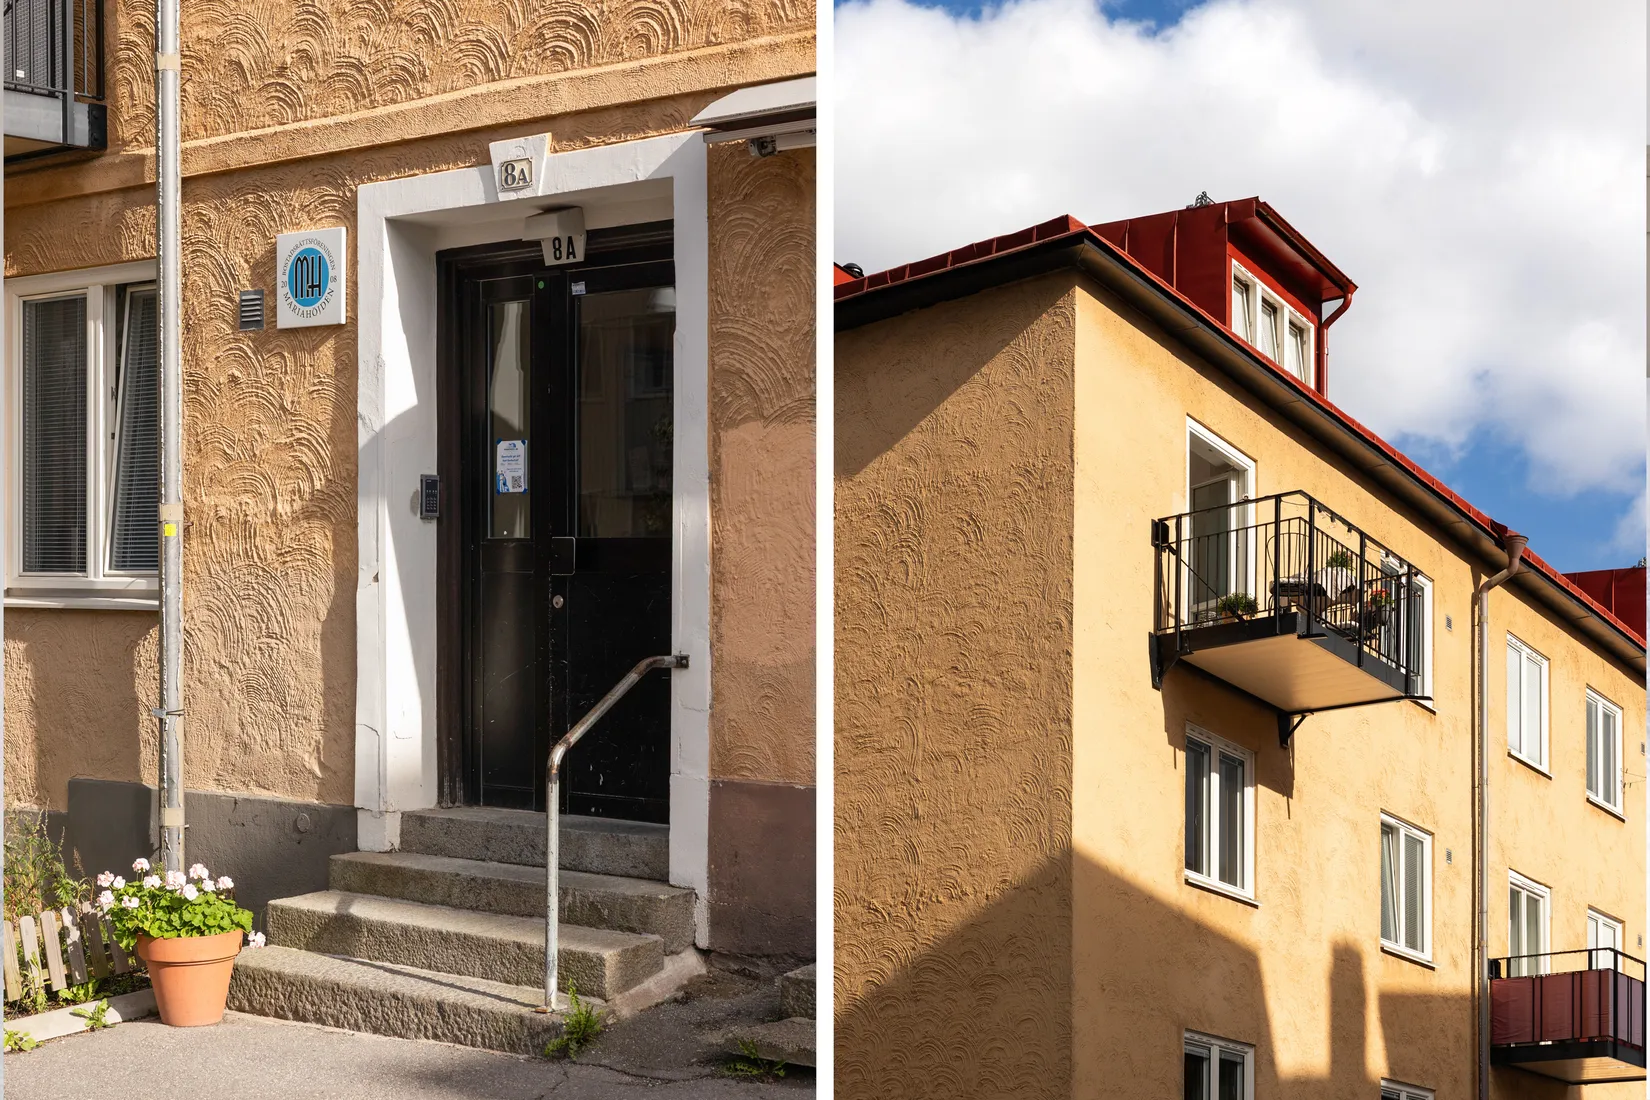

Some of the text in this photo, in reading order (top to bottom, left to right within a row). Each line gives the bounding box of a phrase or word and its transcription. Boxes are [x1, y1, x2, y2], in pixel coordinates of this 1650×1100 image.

[504, 162, 529, 187] 8A
[282, 238, 335, 276] BOSTADSRÄTTSFÖRENINGEN
[552, 235, 577, 261] 8A
[283, 288, 334, 318] MARIAHÖJDEN
